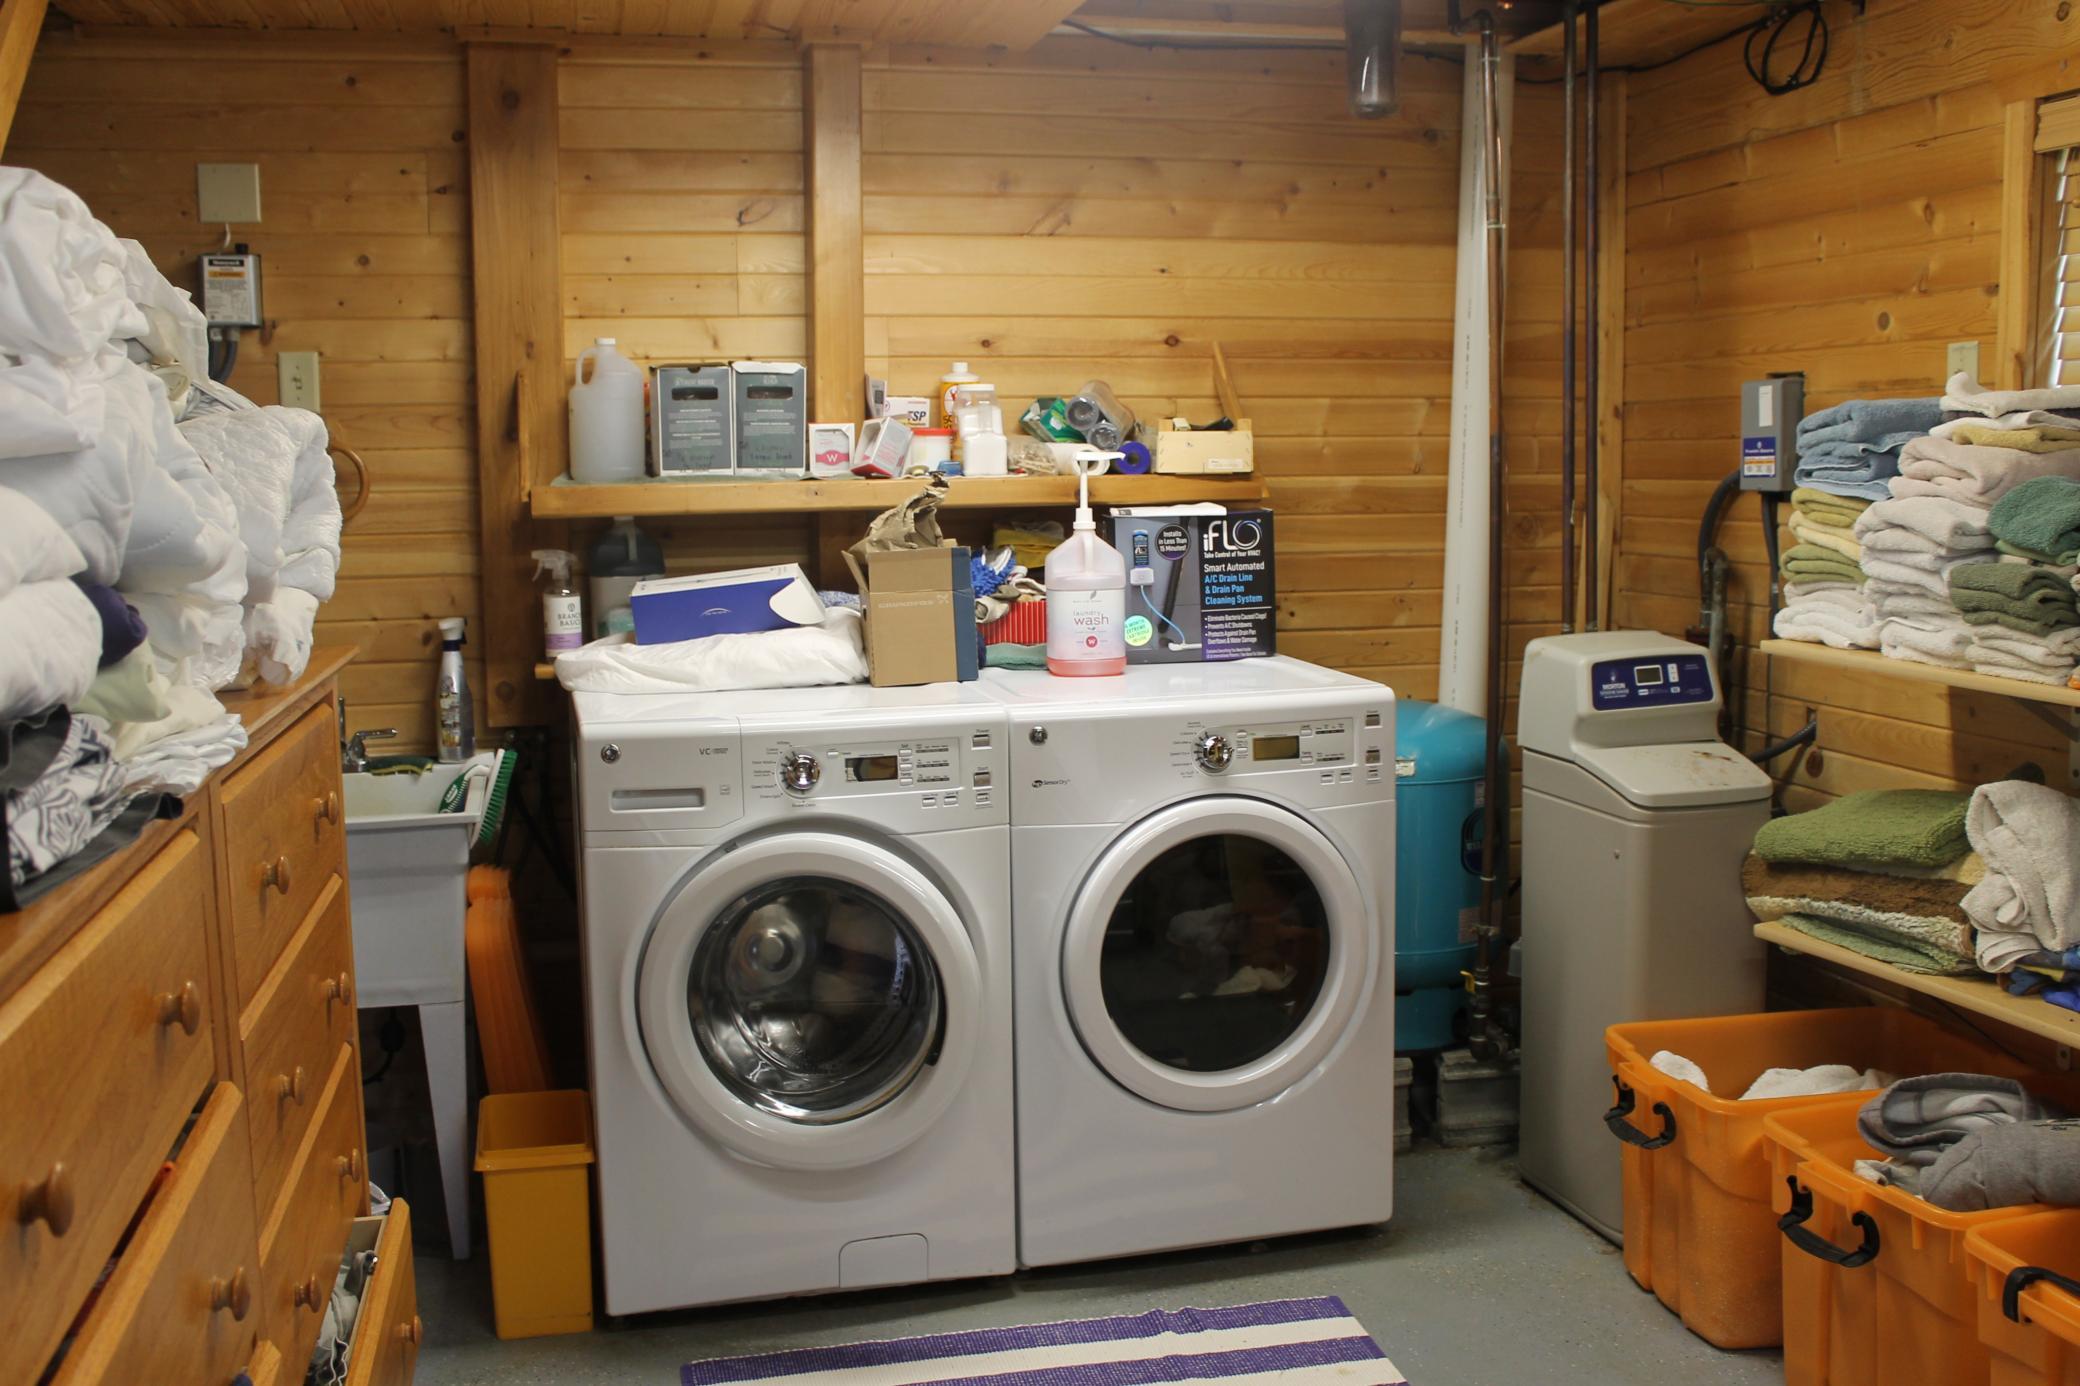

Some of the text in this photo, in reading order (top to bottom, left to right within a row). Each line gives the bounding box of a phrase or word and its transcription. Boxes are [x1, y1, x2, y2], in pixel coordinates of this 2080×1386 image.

[826, 453, 838, 462] W
[1203, 561, 1264, 573] Smart Automated
[1204, 573, 1253, 583] A/C Drain Line
[1205, 584, 1244, 594] & Drain Pan
[1205, 595, 1262, 605] Cleaning System
[1073, 613, 1109, 625] wash
